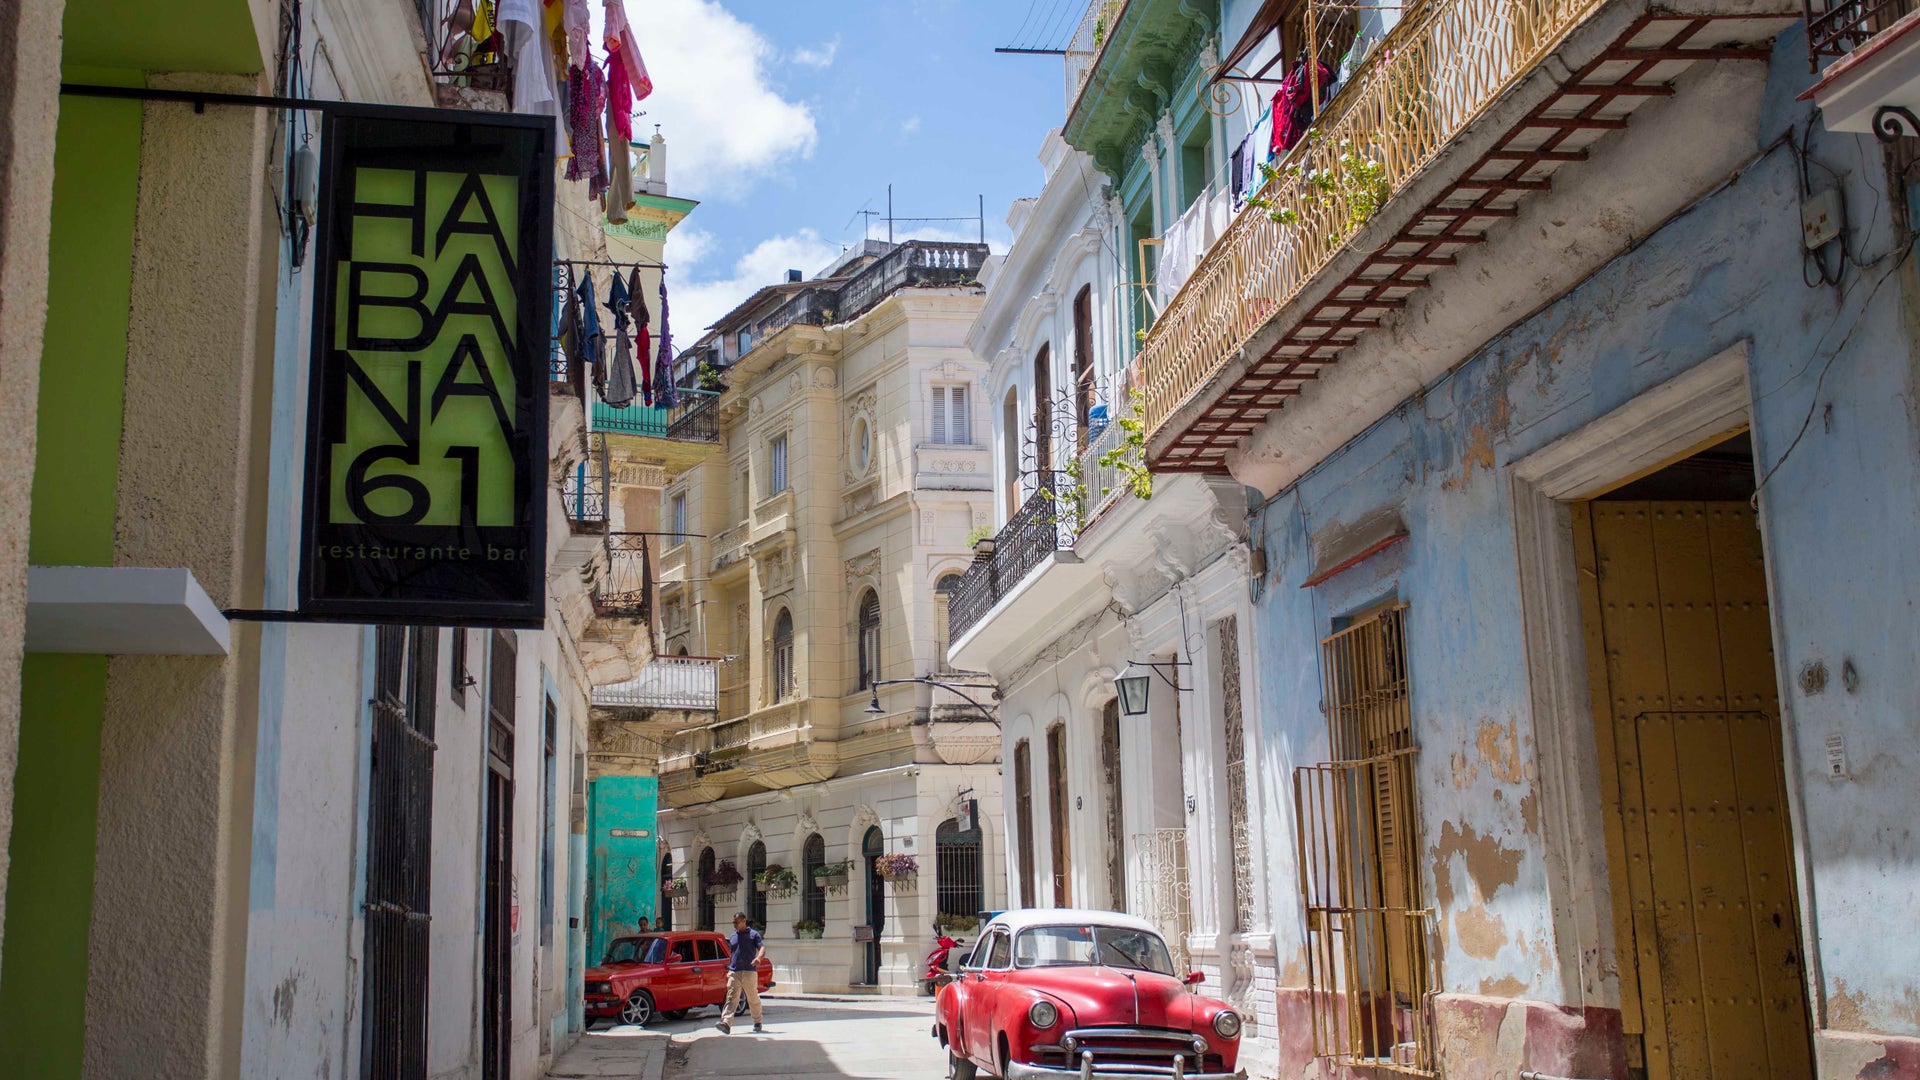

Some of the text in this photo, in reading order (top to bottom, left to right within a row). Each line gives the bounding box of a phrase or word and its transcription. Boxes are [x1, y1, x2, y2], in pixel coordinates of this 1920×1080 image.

[344, 444, 480, 527] 61
[317, 543, 527, 561] restaurante bar
